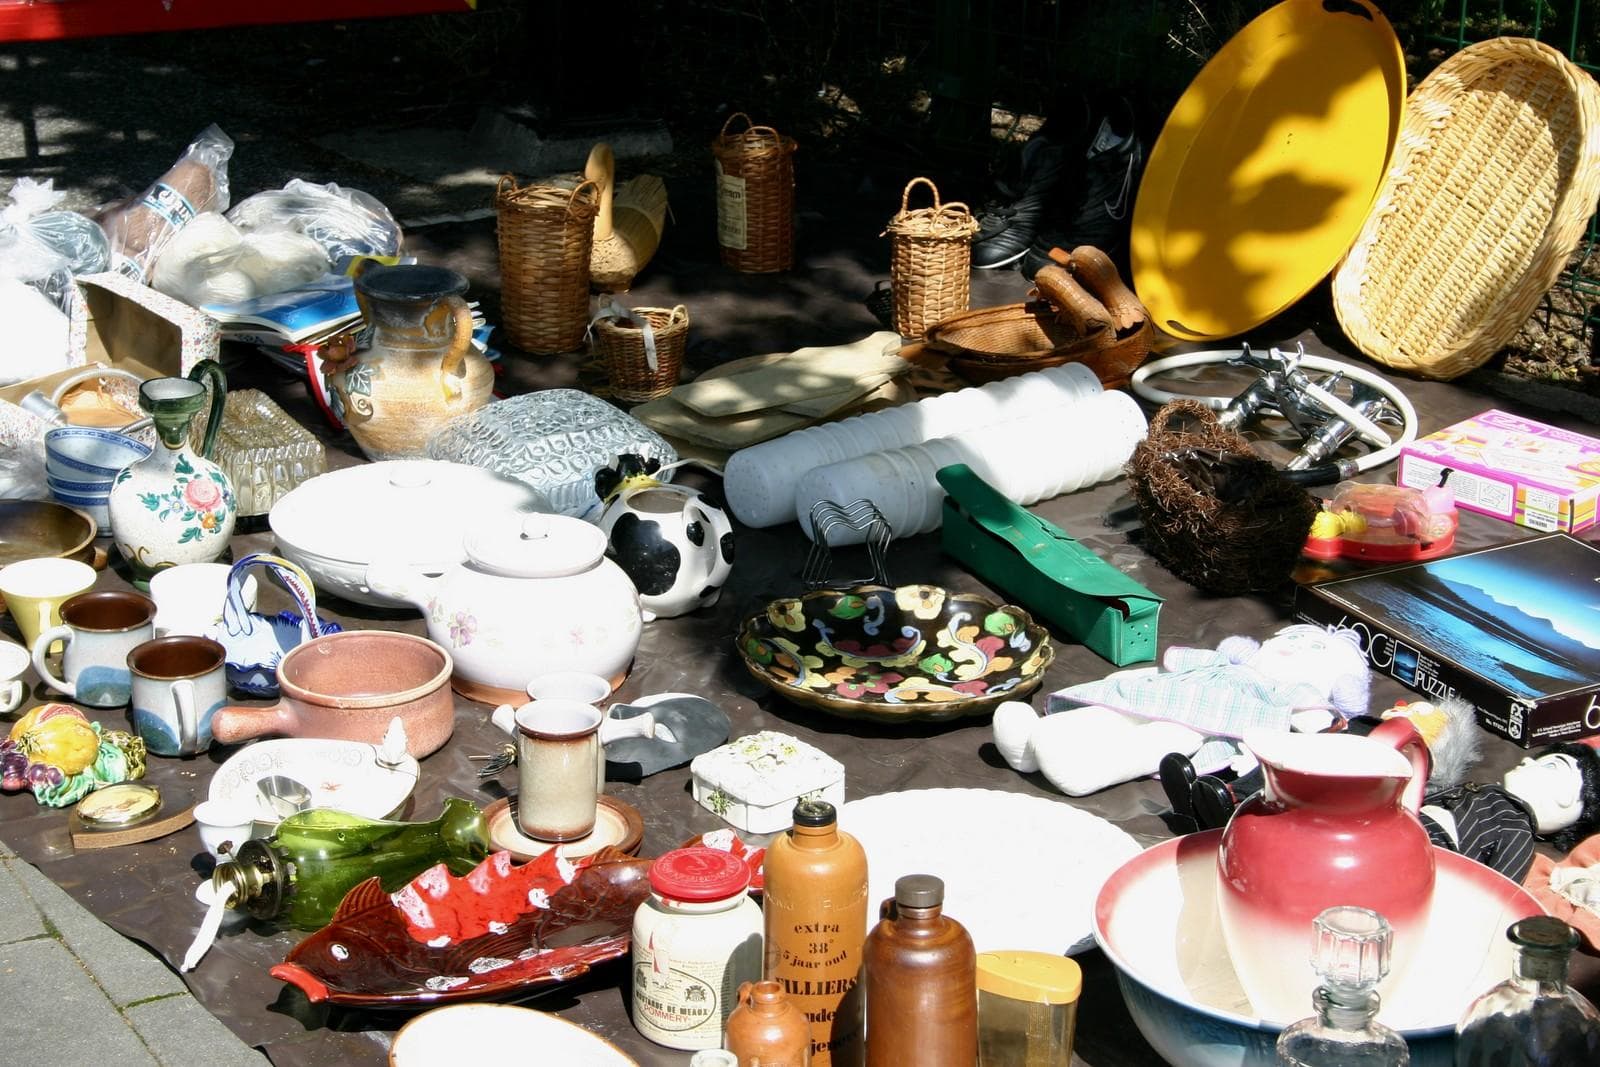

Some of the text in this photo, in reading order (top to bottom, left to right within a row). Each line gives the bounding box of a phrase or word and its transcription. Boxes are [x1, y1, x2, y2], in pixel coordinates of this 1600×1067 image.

[1416, 670, 1456, 701] PUZZLE
[794, 923, 840, 933] extra
[790, 955, 820, 969] jaar
[824, 950, 849, 967] oud
[643, 1003, 689, 1022] POMMERY
[679, 1007, 709, 1016] MEAUX
